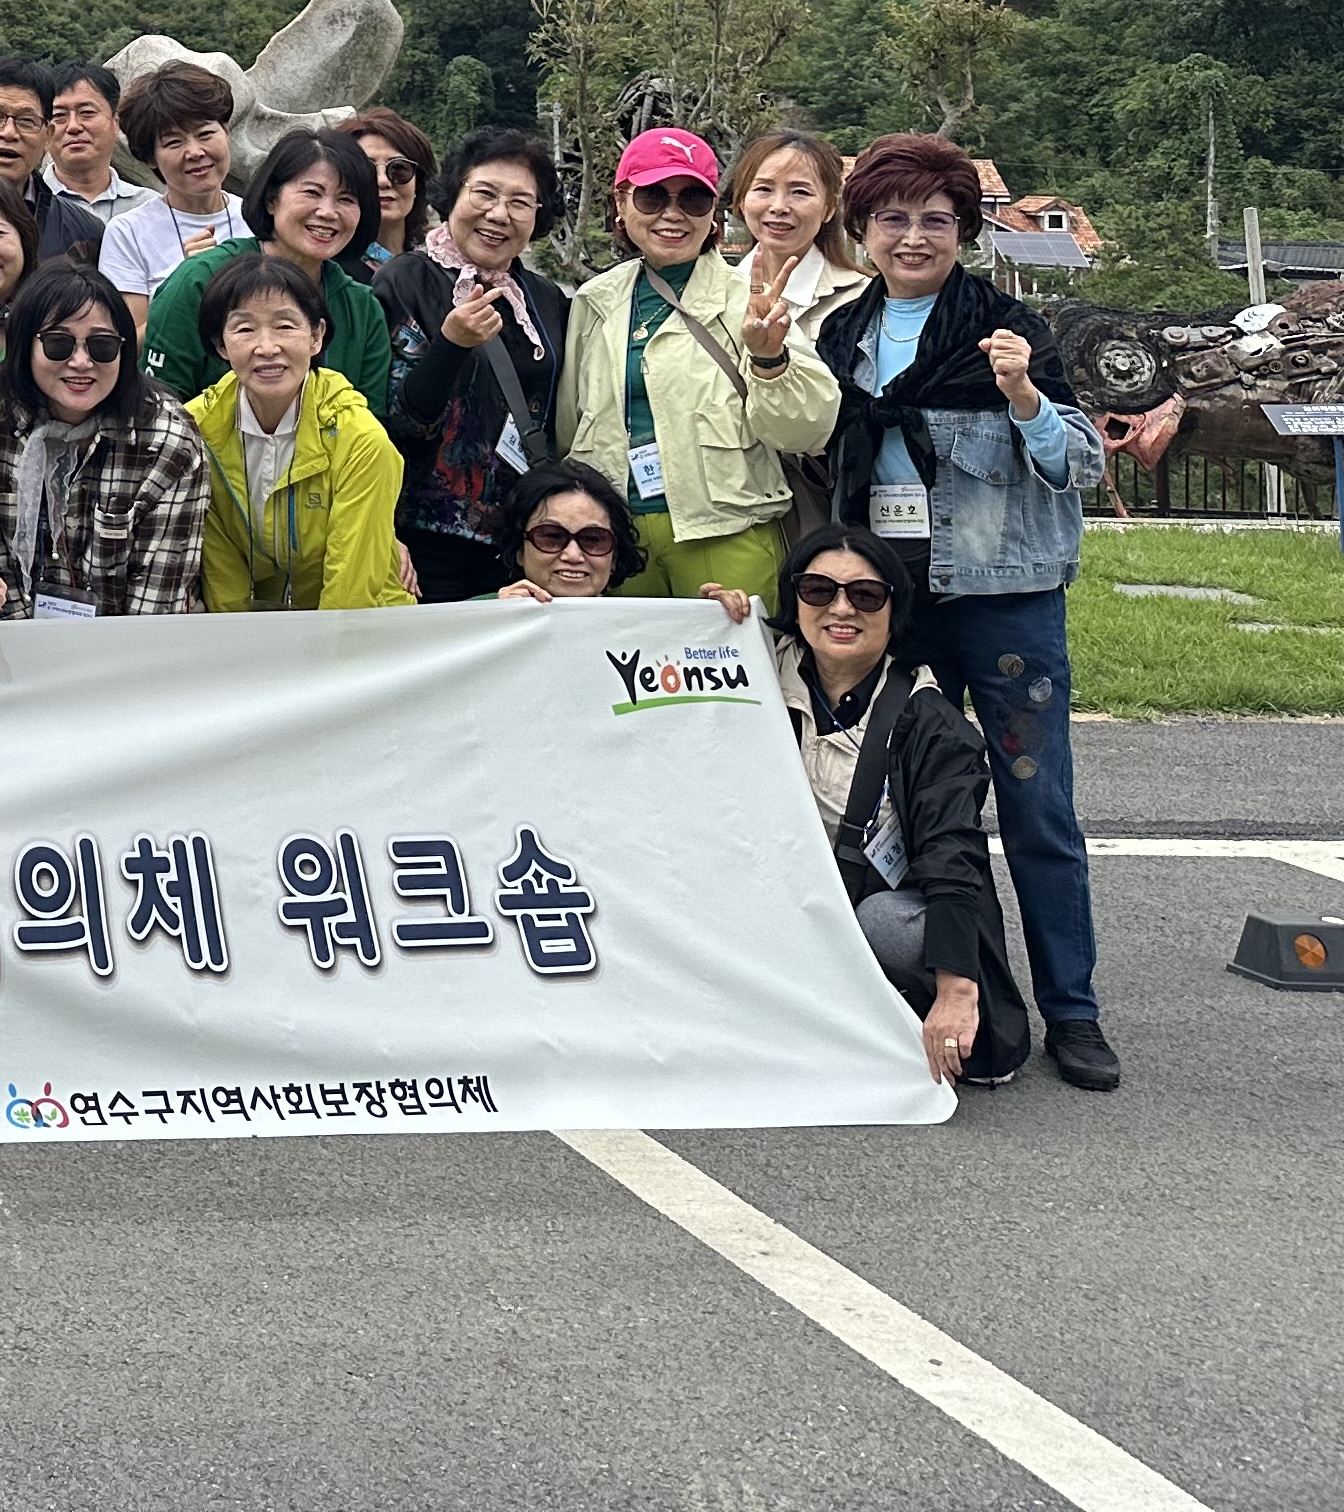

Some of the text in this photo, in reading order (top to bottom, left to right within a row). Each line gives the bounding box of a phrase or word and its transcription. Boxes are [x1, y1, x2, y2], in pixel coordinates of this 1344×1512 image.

[605, 648, 750, 706] Yeonsu
[684, 645, 740, 660] Better life
[277, 825, 601, 978] 워크숍
[69, 1074, 499, 1127] 연수구지역사회보장협의체
